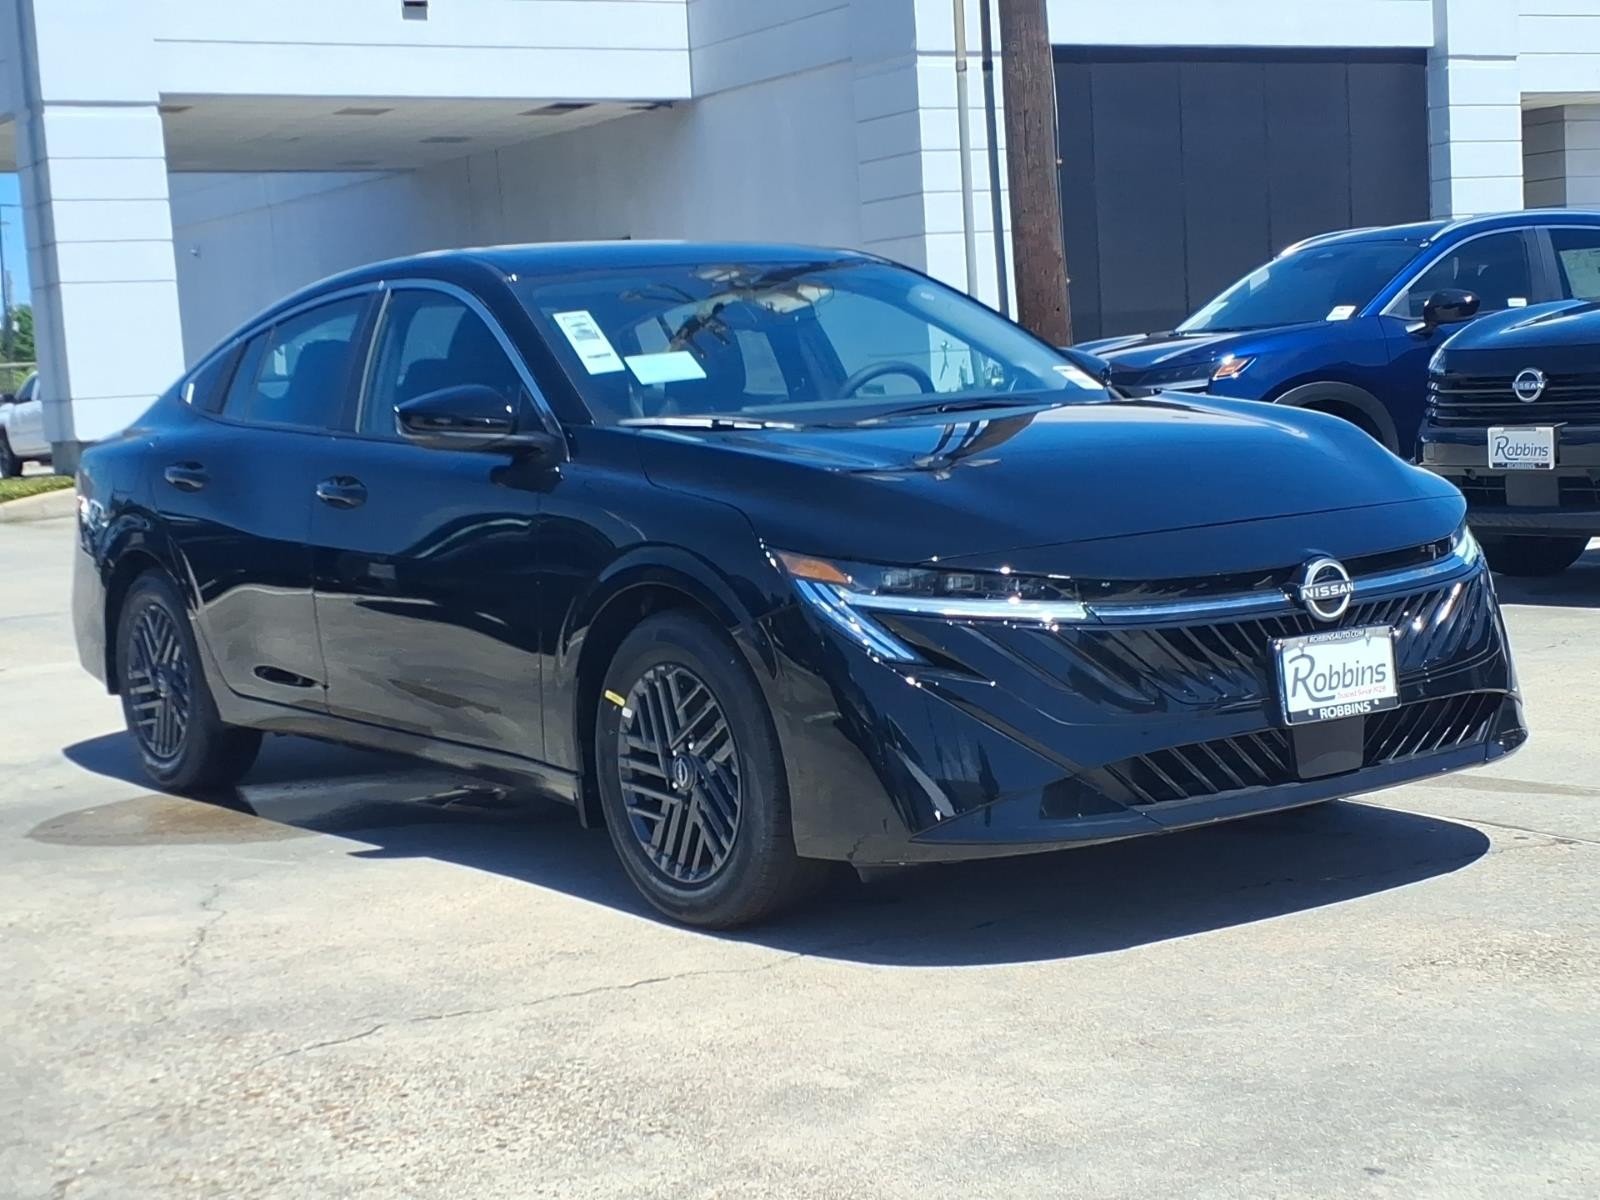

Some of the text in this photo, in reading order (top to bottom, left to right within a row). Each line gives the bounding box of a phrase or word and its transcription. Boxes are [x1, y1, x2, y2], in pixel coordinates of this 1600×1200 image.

[1494, 436, 1549, 461] Robbins
[1301, 581, 1354, 600] NISSAN
[1288, 653, 1386, 702] Robbins
[1319, 701, 1371, 719] ROBBINS
